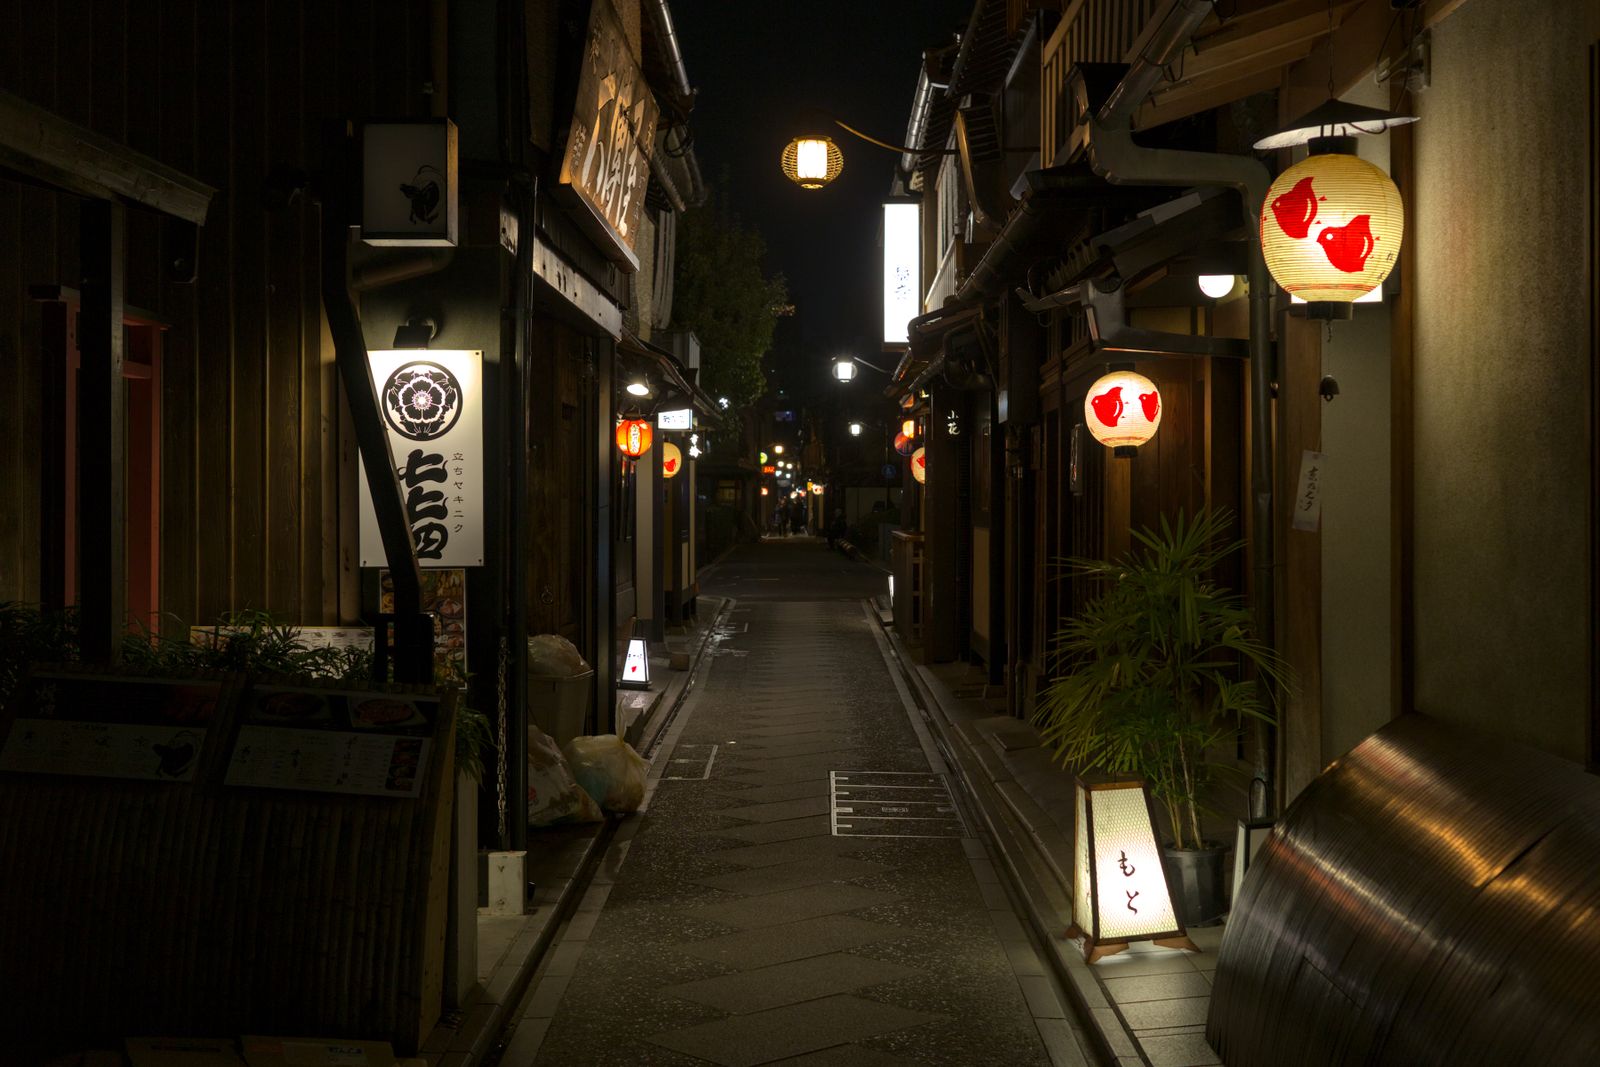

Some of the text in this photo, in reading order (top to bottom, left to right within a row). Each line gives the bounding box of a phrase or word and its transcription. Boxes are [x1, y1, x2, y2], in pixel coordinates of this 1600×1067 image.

[947, 410, 961, 435] 小花
[452, 452, 465, 533] 立ちヤキニク
[1117, 849, 1140, 916] もと
